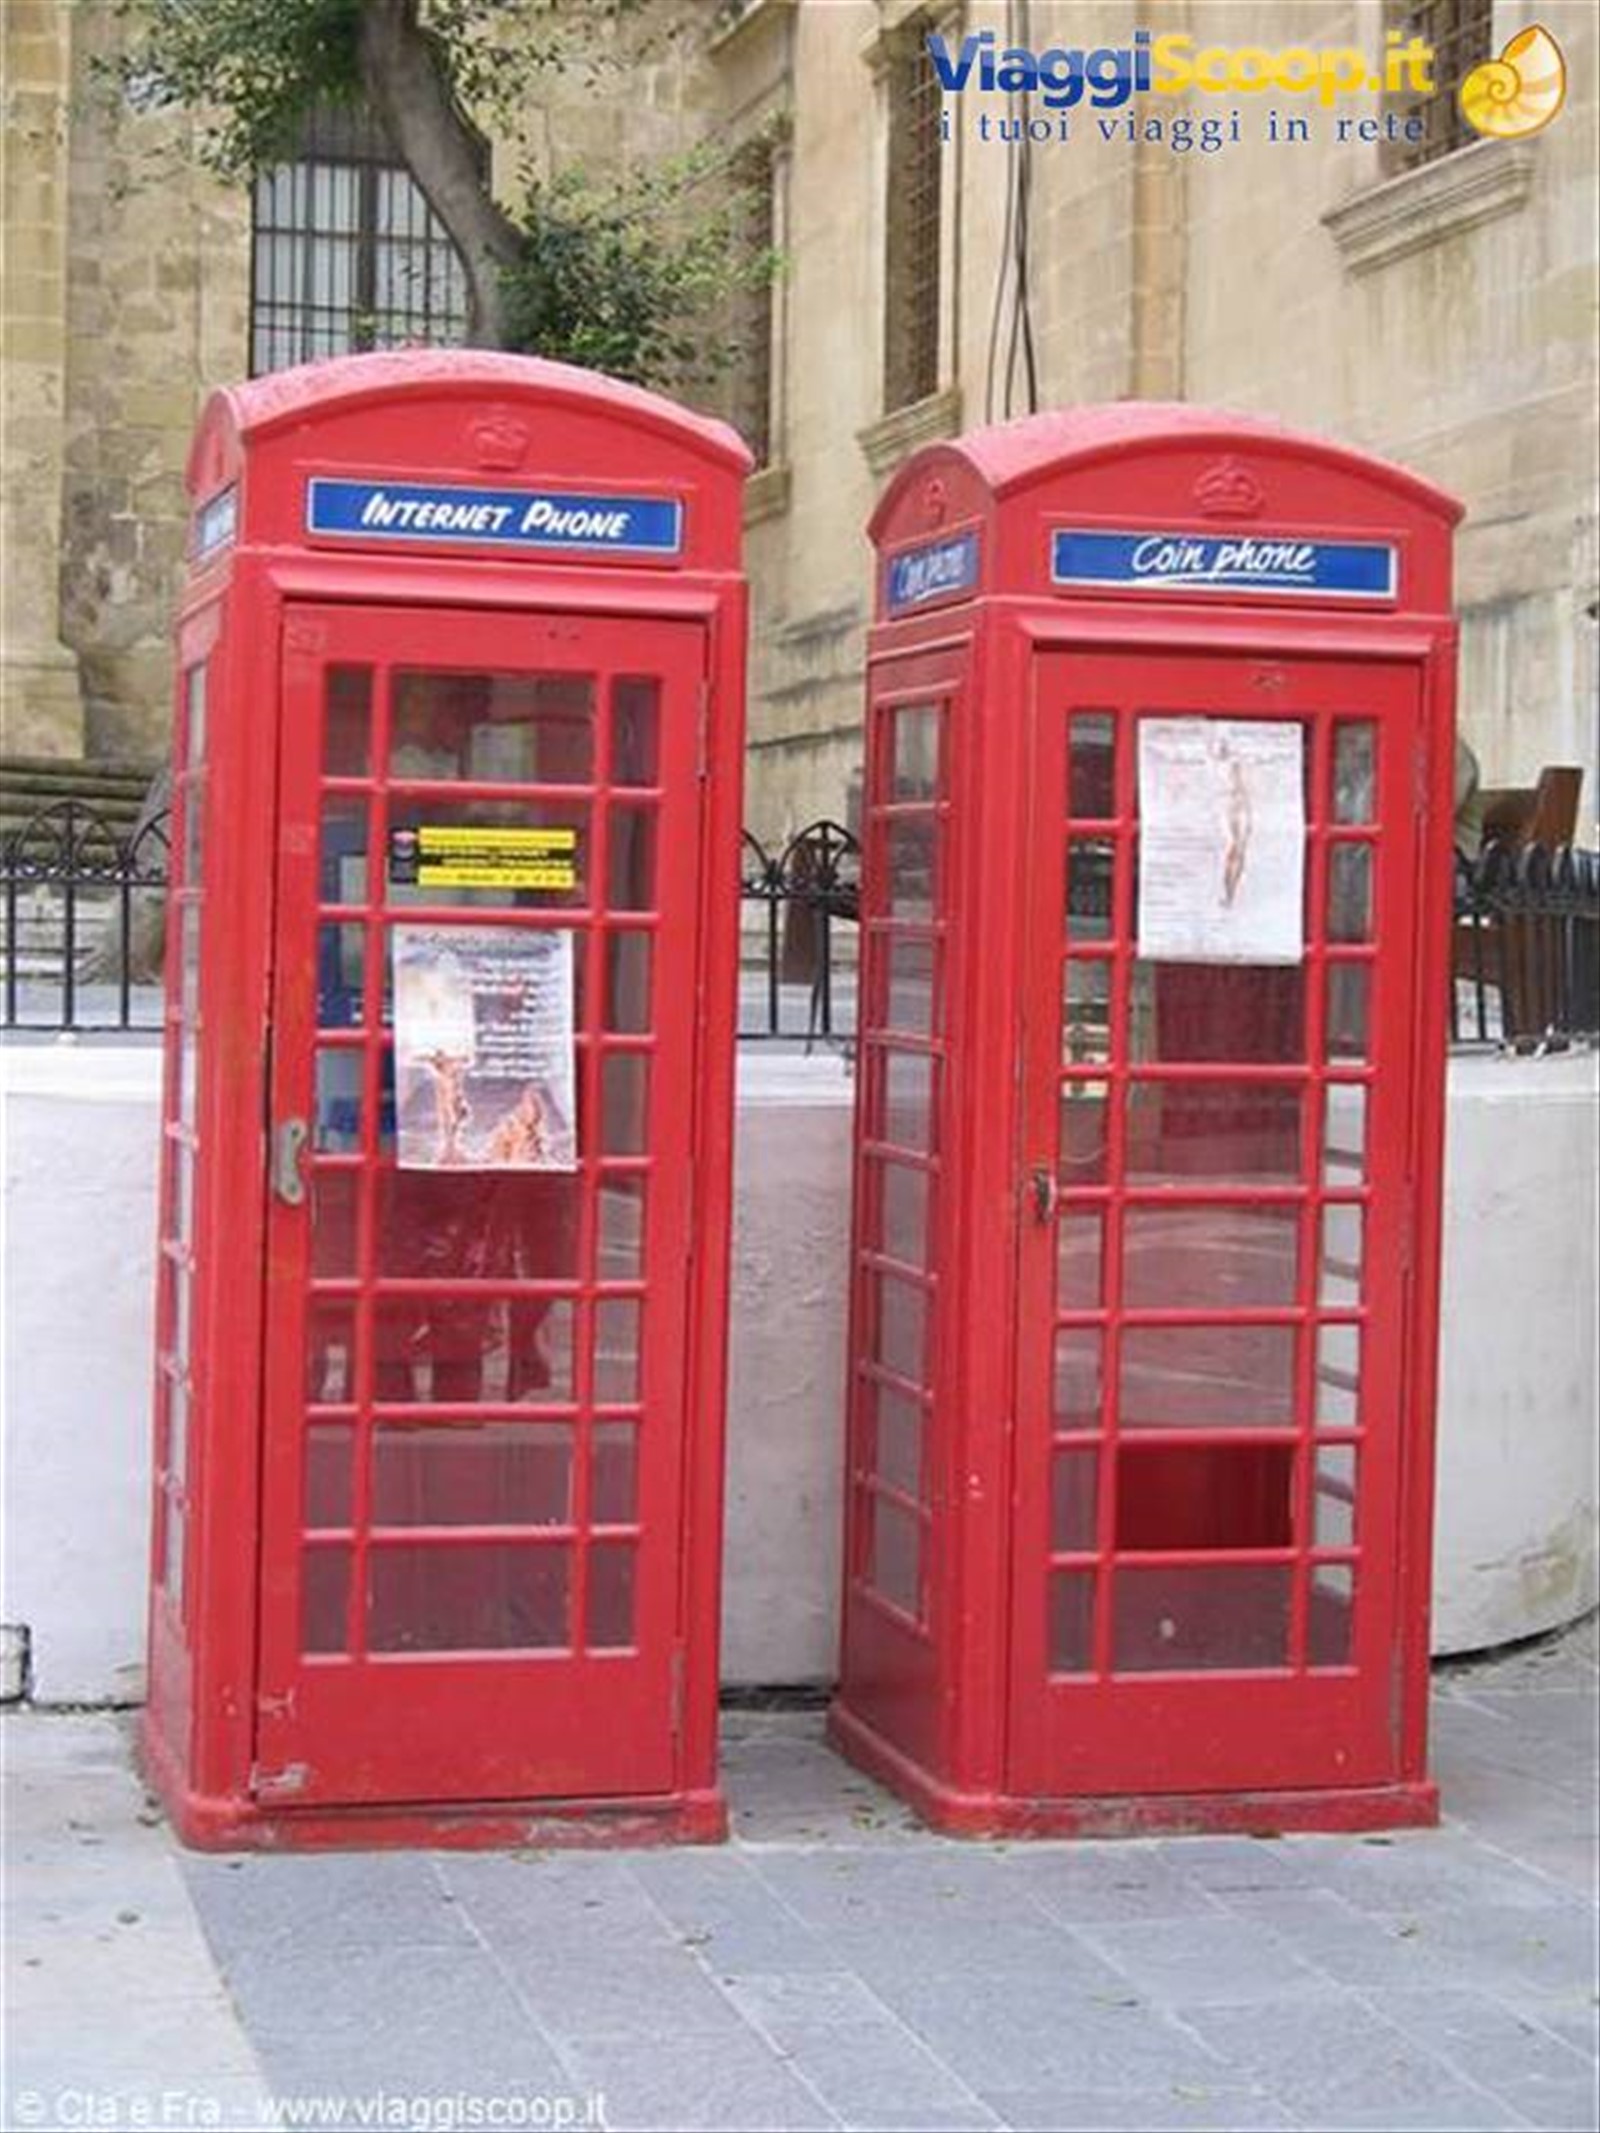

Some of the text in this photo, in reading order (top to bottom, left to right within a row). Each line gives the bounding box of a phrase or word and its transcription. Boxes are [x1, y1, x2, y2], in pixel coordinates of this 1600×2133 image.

[361, 492, 631, 538] INTERNET PHONE
[1131, 537, 1317, 580] Coin phone
